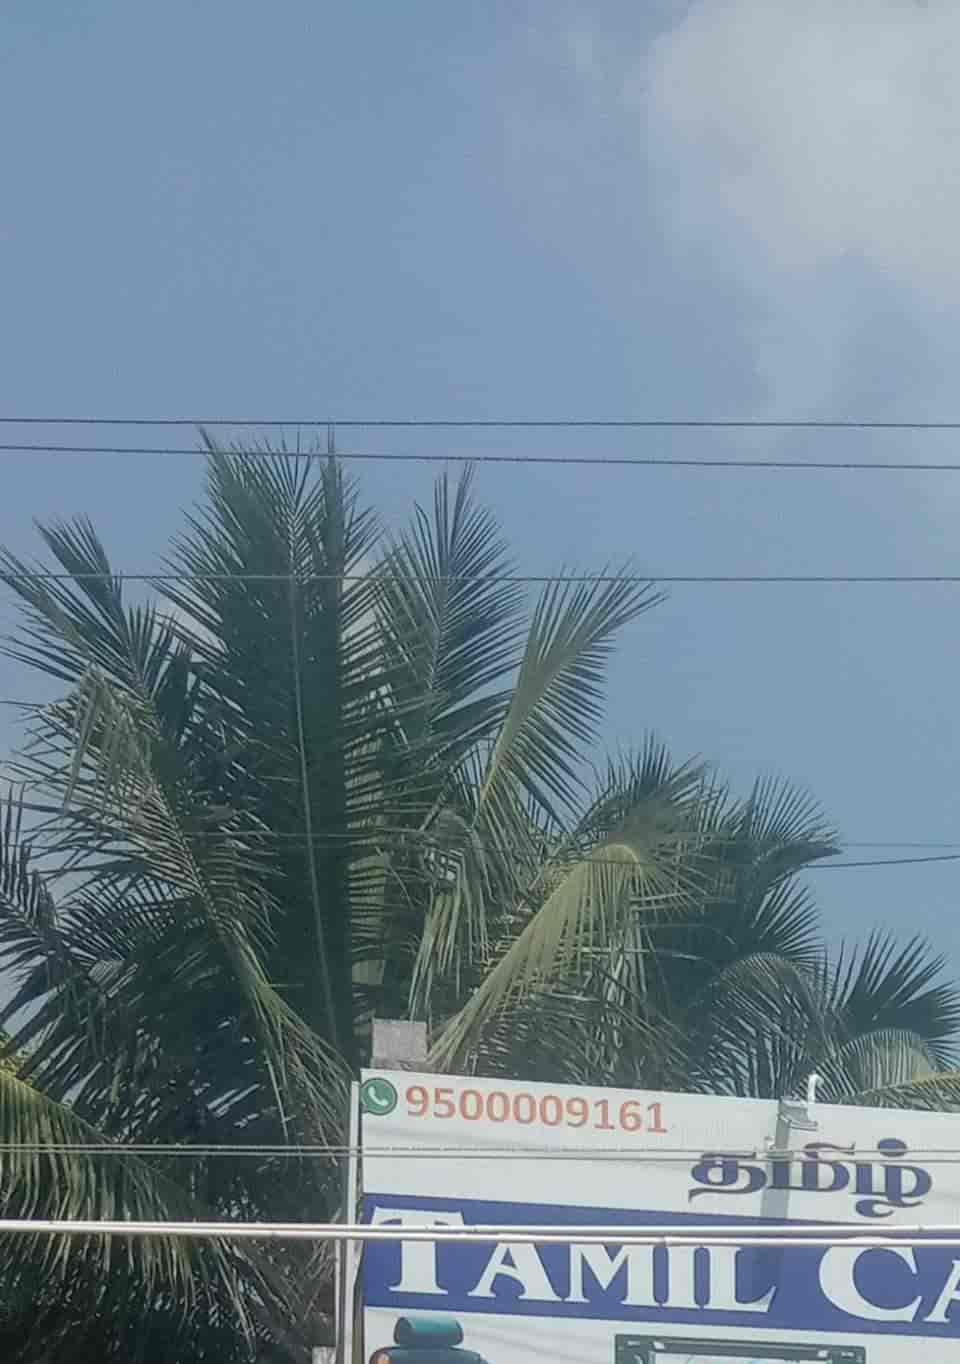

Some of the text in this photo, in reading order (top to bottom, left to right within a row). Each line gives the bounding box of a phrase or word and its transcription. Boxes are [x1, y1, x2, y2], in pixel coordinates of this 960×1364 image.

[406, 1085, 668, 1134] 9500009161
[688, 1137, 933, 1219] தமிழ்
[371, 1206, 777, 1313] TAMIL
